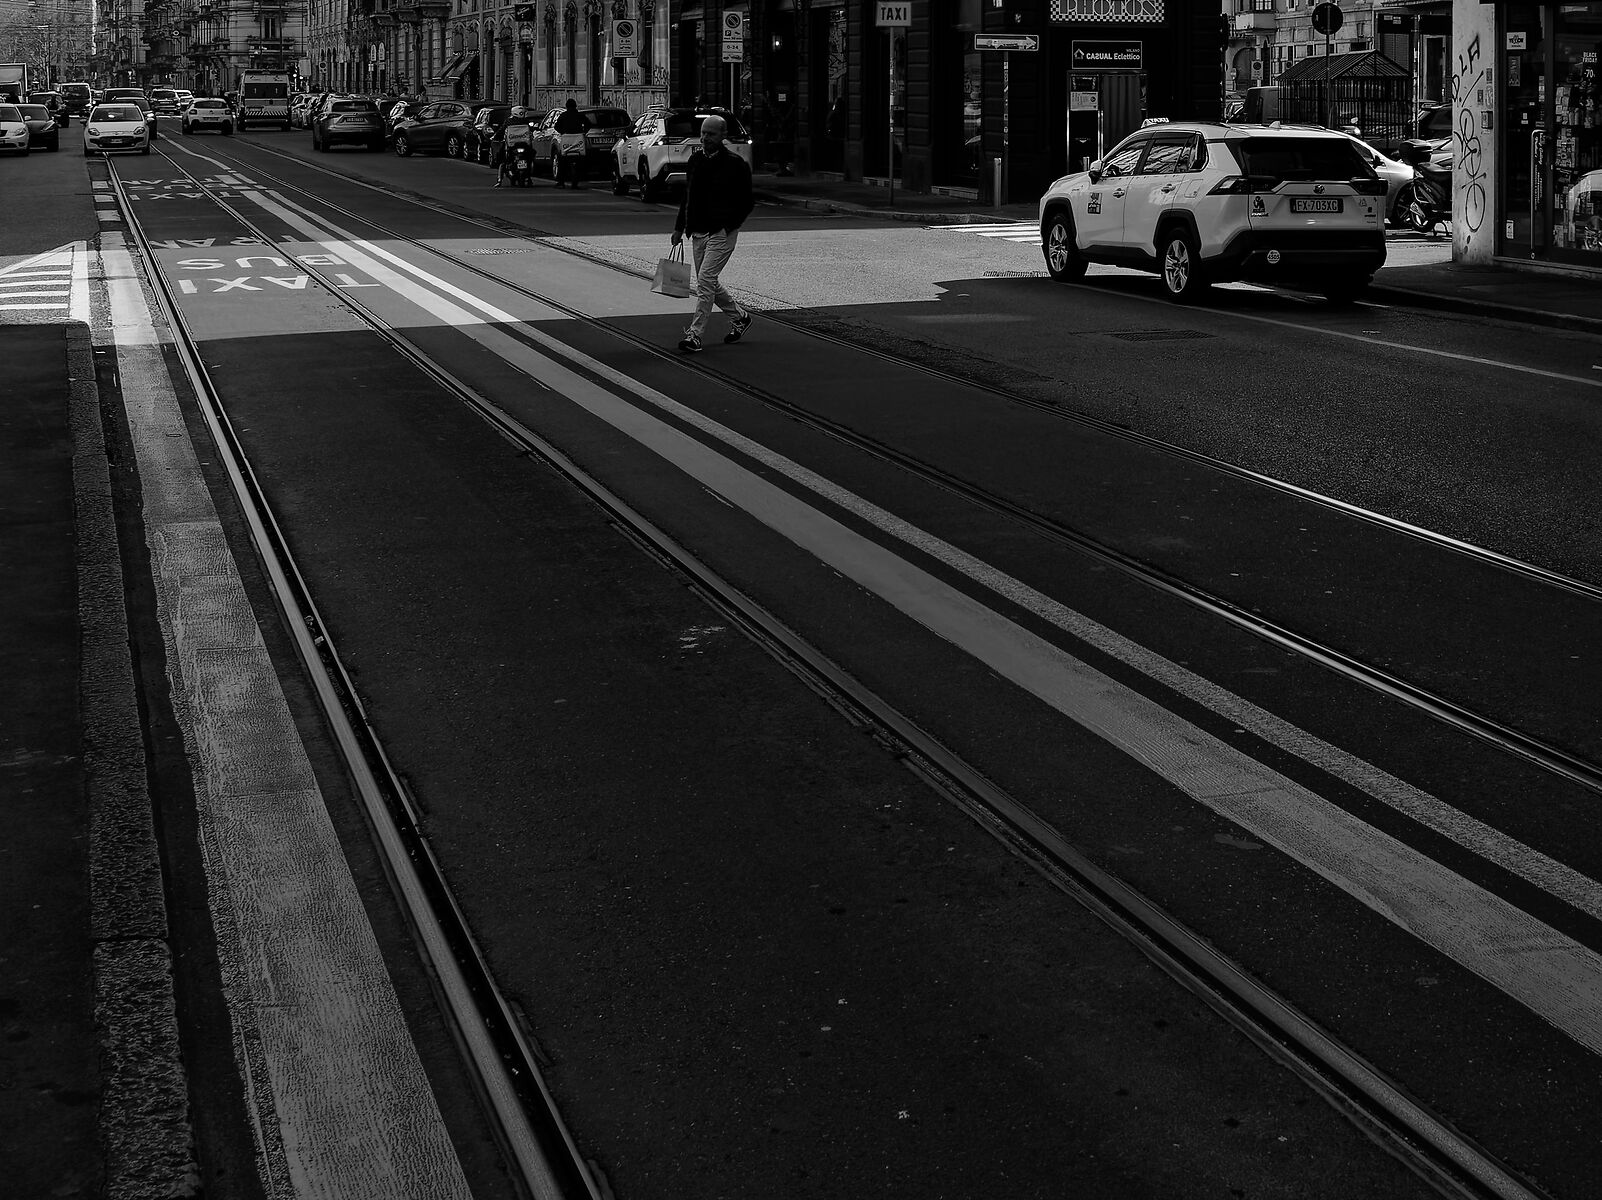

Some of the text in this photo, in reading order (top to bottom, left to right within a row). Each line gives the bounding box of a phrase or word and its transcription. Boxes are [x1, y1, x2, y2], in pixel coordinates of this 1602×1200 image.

[881, 7, 907, 21] TAXI
[1086, 52, 1141, 60] CASUAL Eclettico
[129, 191, 242, 201] TAXI
[176, 253, 347, 270] BUS
[178, 273, 381, 294] TAXI
